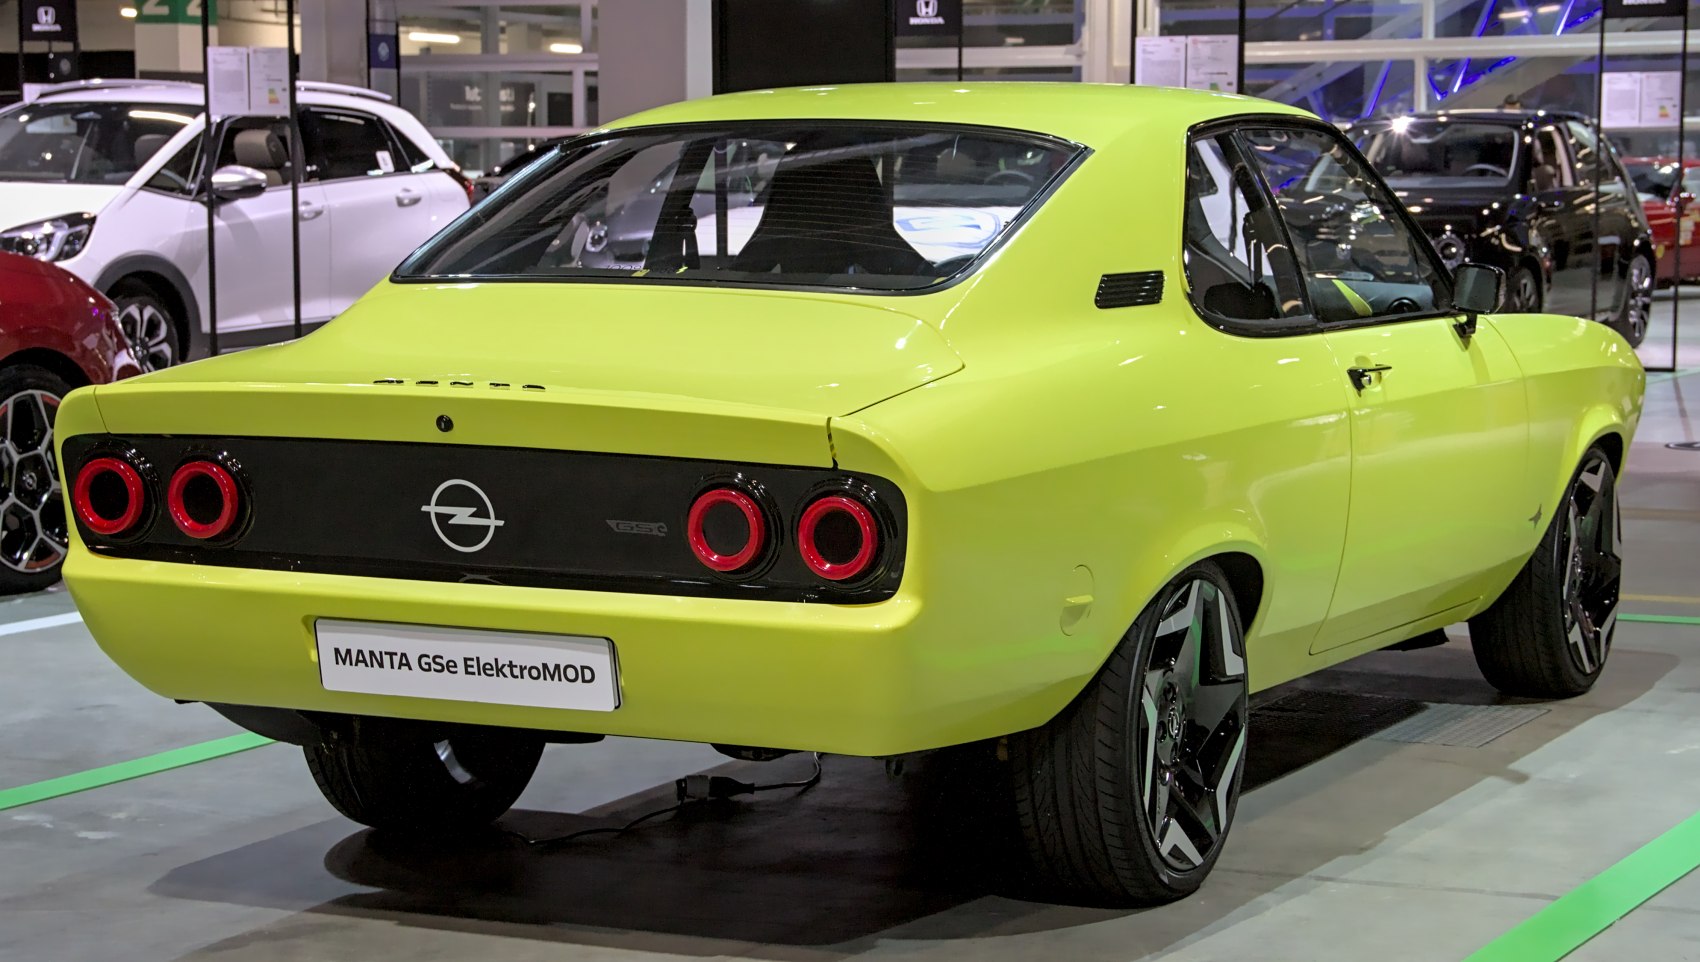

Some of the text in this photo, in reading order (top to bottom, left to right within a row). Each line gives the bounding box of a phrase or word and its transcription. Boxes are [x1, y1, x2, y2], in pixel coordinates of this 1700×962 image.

[333, 647, 596, 685] MANTA GSe ElektroMOD
